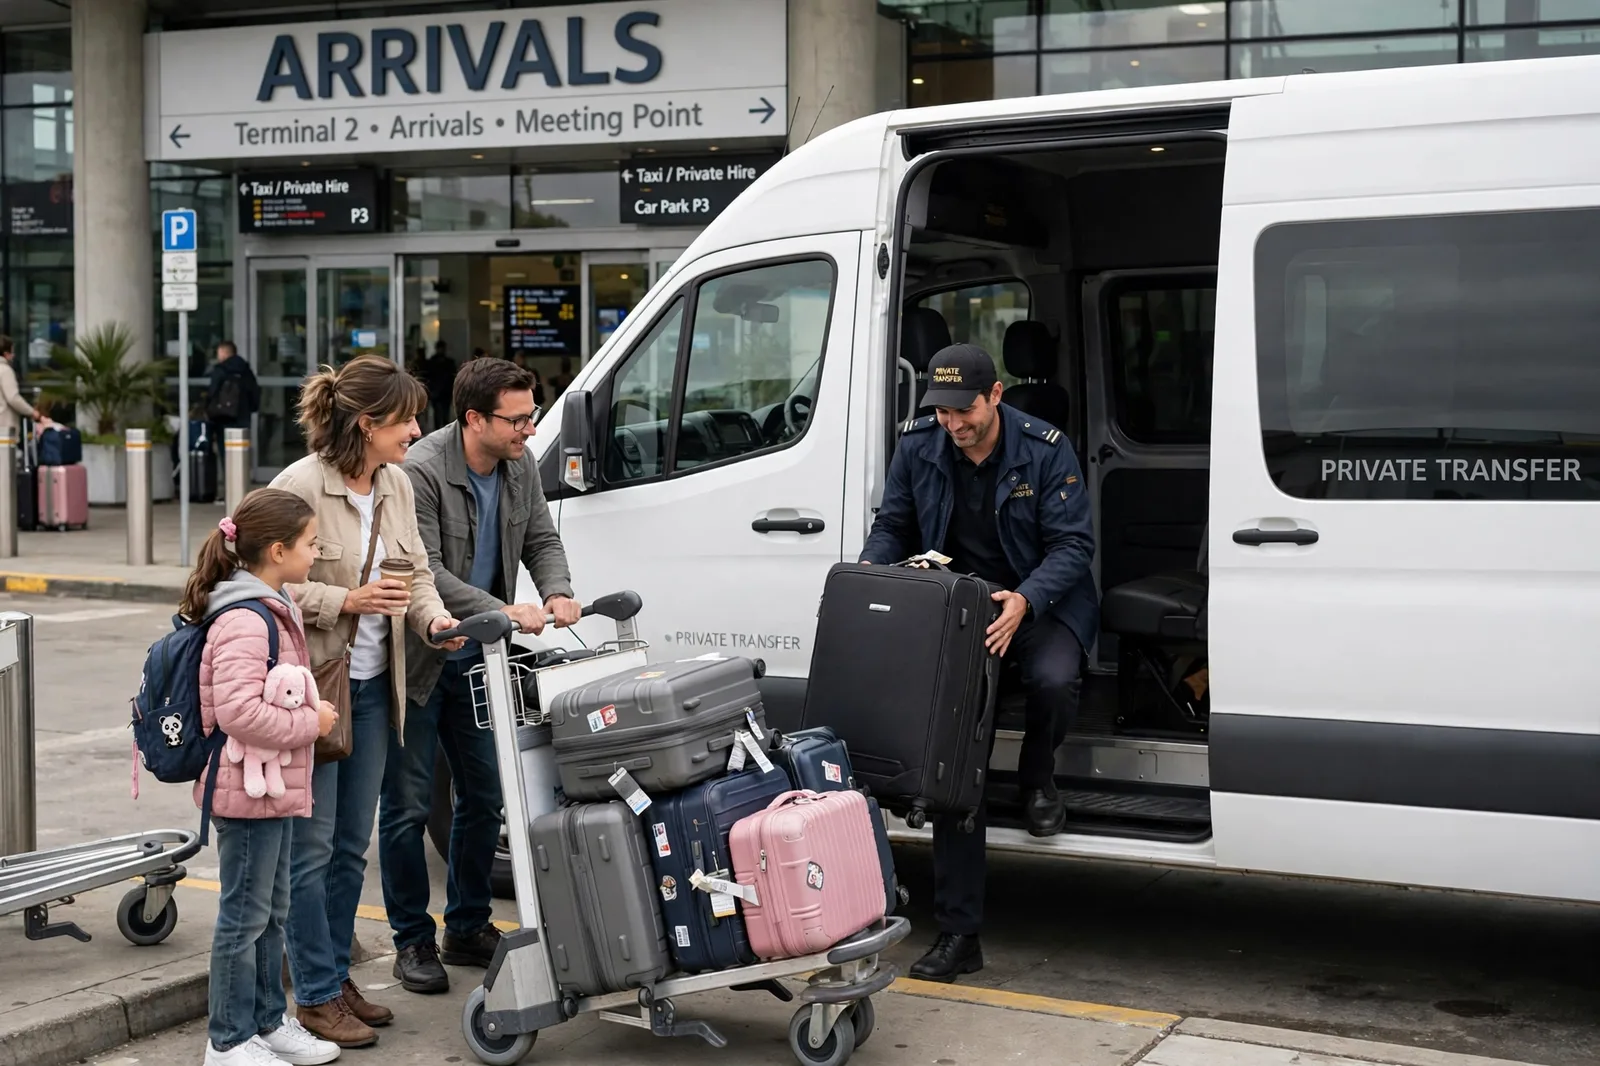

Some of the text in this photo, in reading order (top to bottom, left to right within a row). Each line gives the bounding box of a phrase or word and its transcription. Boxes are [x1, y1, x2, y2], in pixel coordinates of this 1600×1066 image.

[256, 11, 663, 102] ARRIVALS
[234, 101, 703, 146] Terminal 2 Arrivals Meeting Point
[635, 167, 664, 184] Taxi
[676, 165, 724, 182] Private
[727, 164, 757, 180] Hire
[251, 181, 274, 196] Taxi
[283, 180, 323, 195] Private
[325, 179, 349, 194] Hire
[350, 207, 369, 224] P3
[634, 197, 710, 215] Car Park P3
[170, 215, 189, 247] P
[1321, 458, 1582, 482] PRIVATE TRANSFER
[675, 631, 801, 650] PRIVATE TRANSFER
